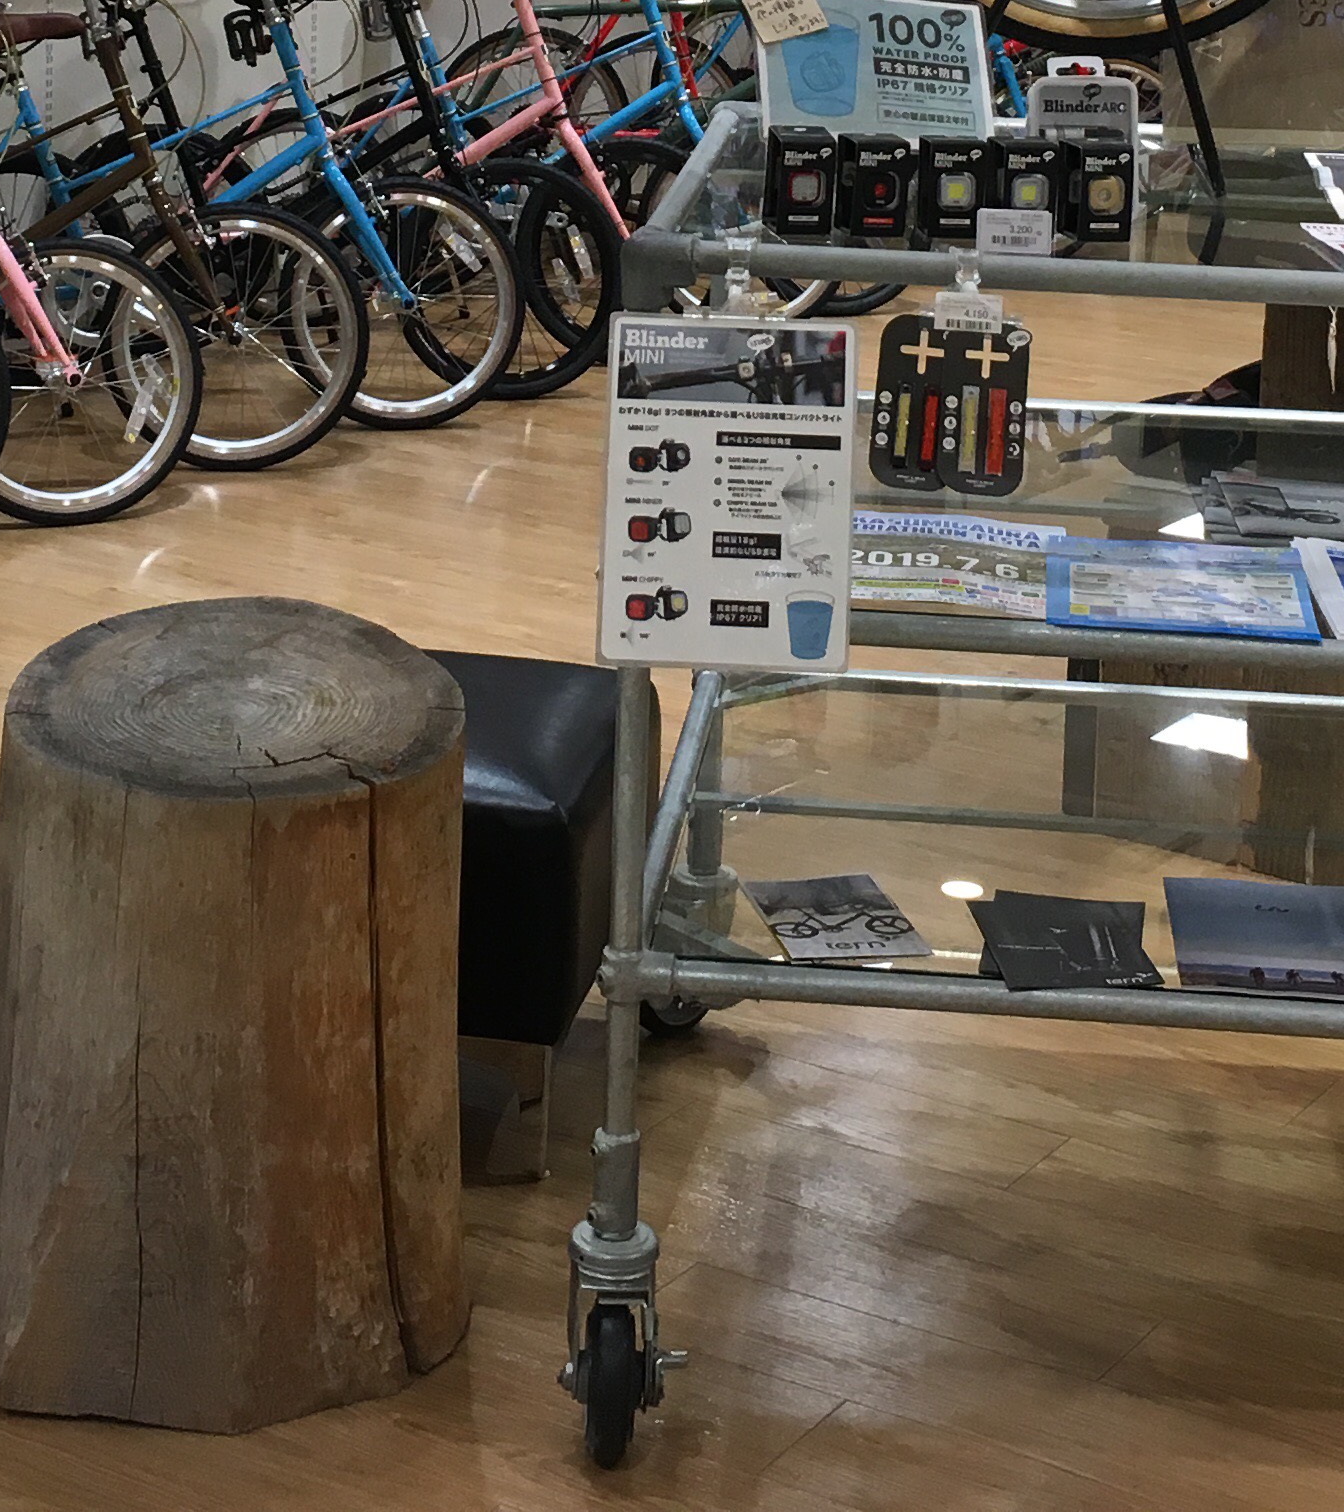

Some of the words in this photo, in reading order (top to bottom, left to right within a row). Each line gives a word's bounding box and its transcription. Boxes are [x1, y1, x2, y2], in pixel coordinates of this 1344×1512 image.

[868, 11, 965, 53] 100%
[872, 46, 920, 61] WATER
[924, 51, 968, 64] PROOF
[625, 329, 709, 350] Blinder
[623, 348, 665, 365] MINI
